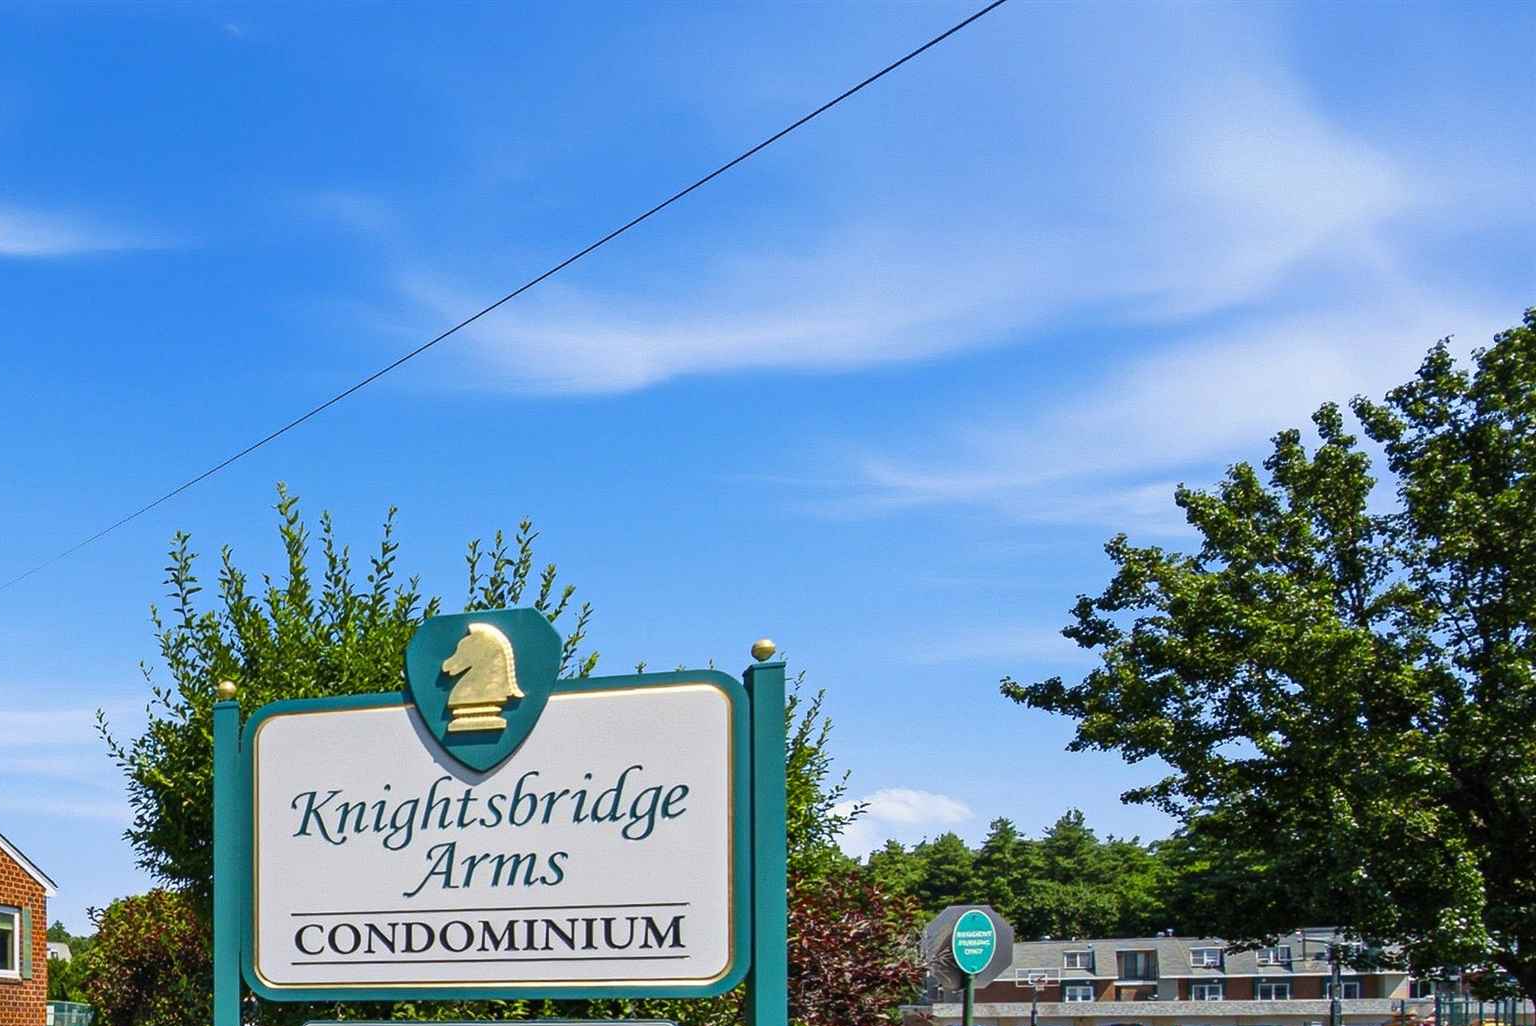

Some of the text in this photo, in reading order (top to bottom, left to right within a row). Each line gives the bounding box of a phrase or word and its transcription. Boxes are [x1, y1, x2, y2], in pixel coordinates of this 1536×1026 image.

[290, 764, 690, 851] Knightsbridge
[402, 840, 569, 898] Arms
[293, 914, 687, 955] CONDOMINIUM
